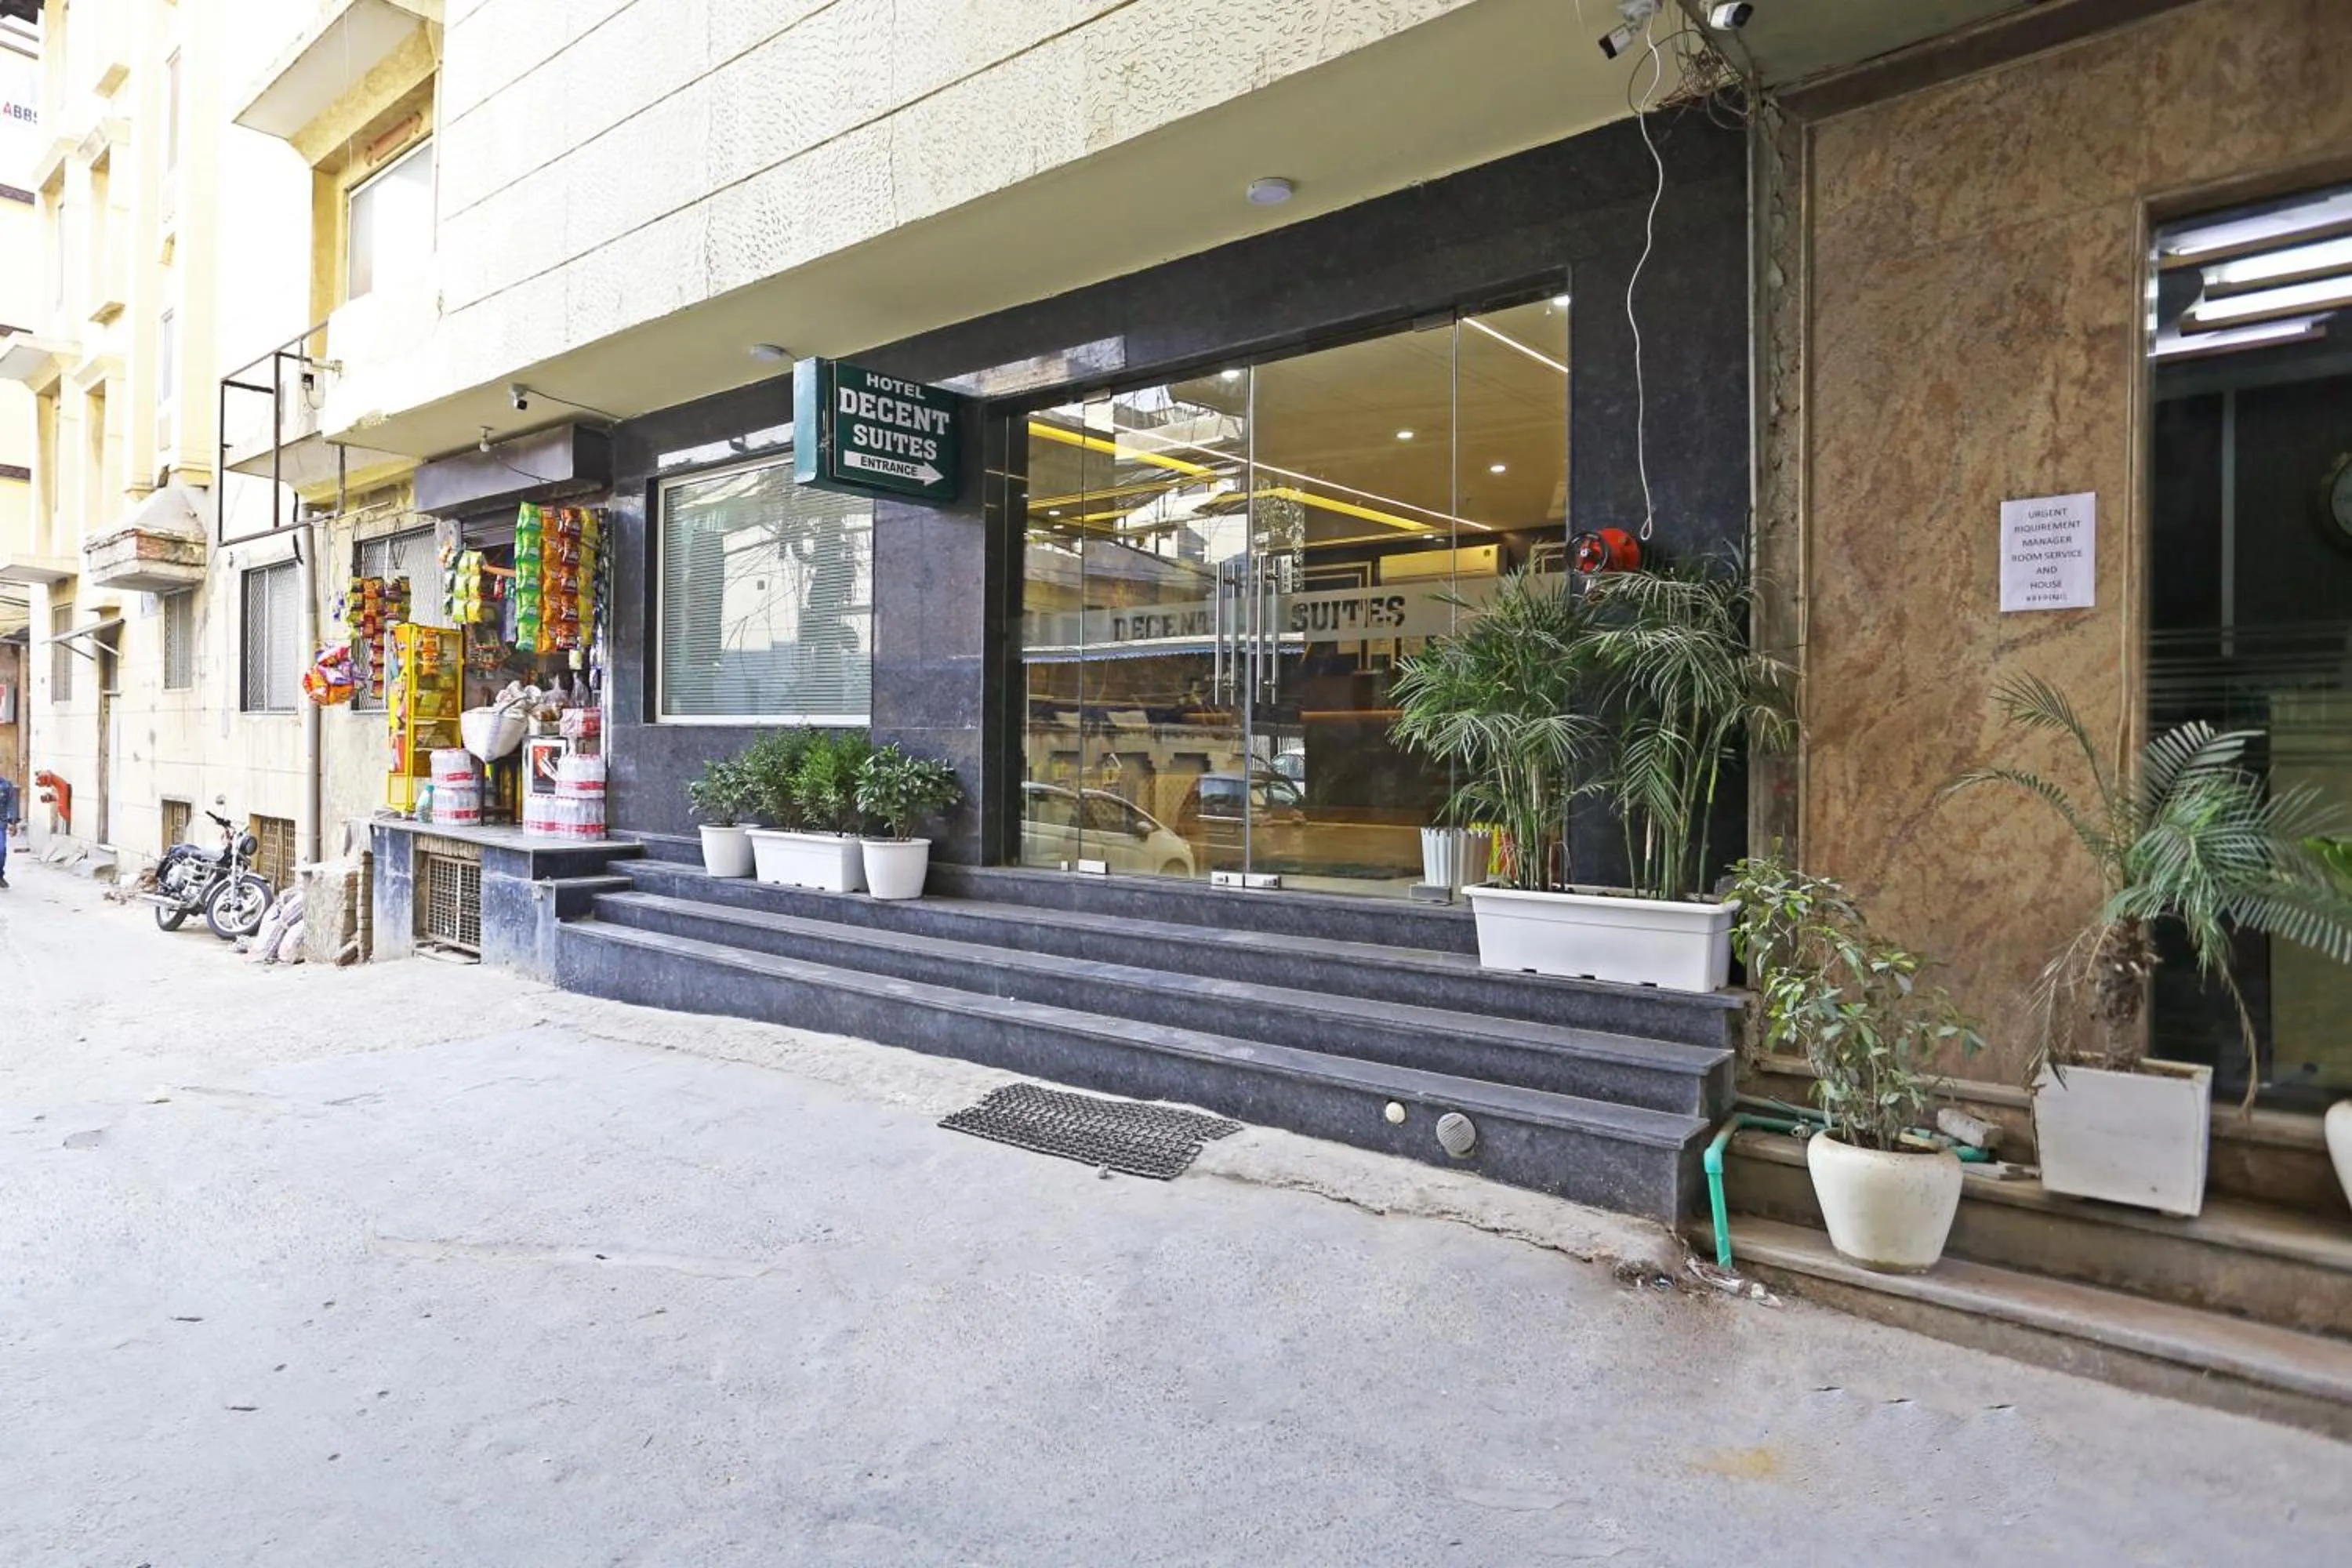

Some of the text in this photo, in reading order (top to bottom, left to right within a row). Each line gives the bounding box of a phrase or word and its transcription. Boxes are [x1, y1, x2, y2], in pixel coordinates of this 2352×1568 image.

[866, 372, 926, 400] HOTEL
[839, 387, 950, 435] DECENT
[853, 423, 937, 460] SUITES
[860, 456, 918, 477] ENTRANCE
[2028, 508, 2067, 518] URGENT
[2022, 536, 2072, 546] MANAGER
[2011, 550, 2082, 562] ROOM SERVICE
[2035, 565, 2057, 575] AND
[2030, 580, 2062, 589] HOUSE
[1292, 596, 1405, 631] SUITES
